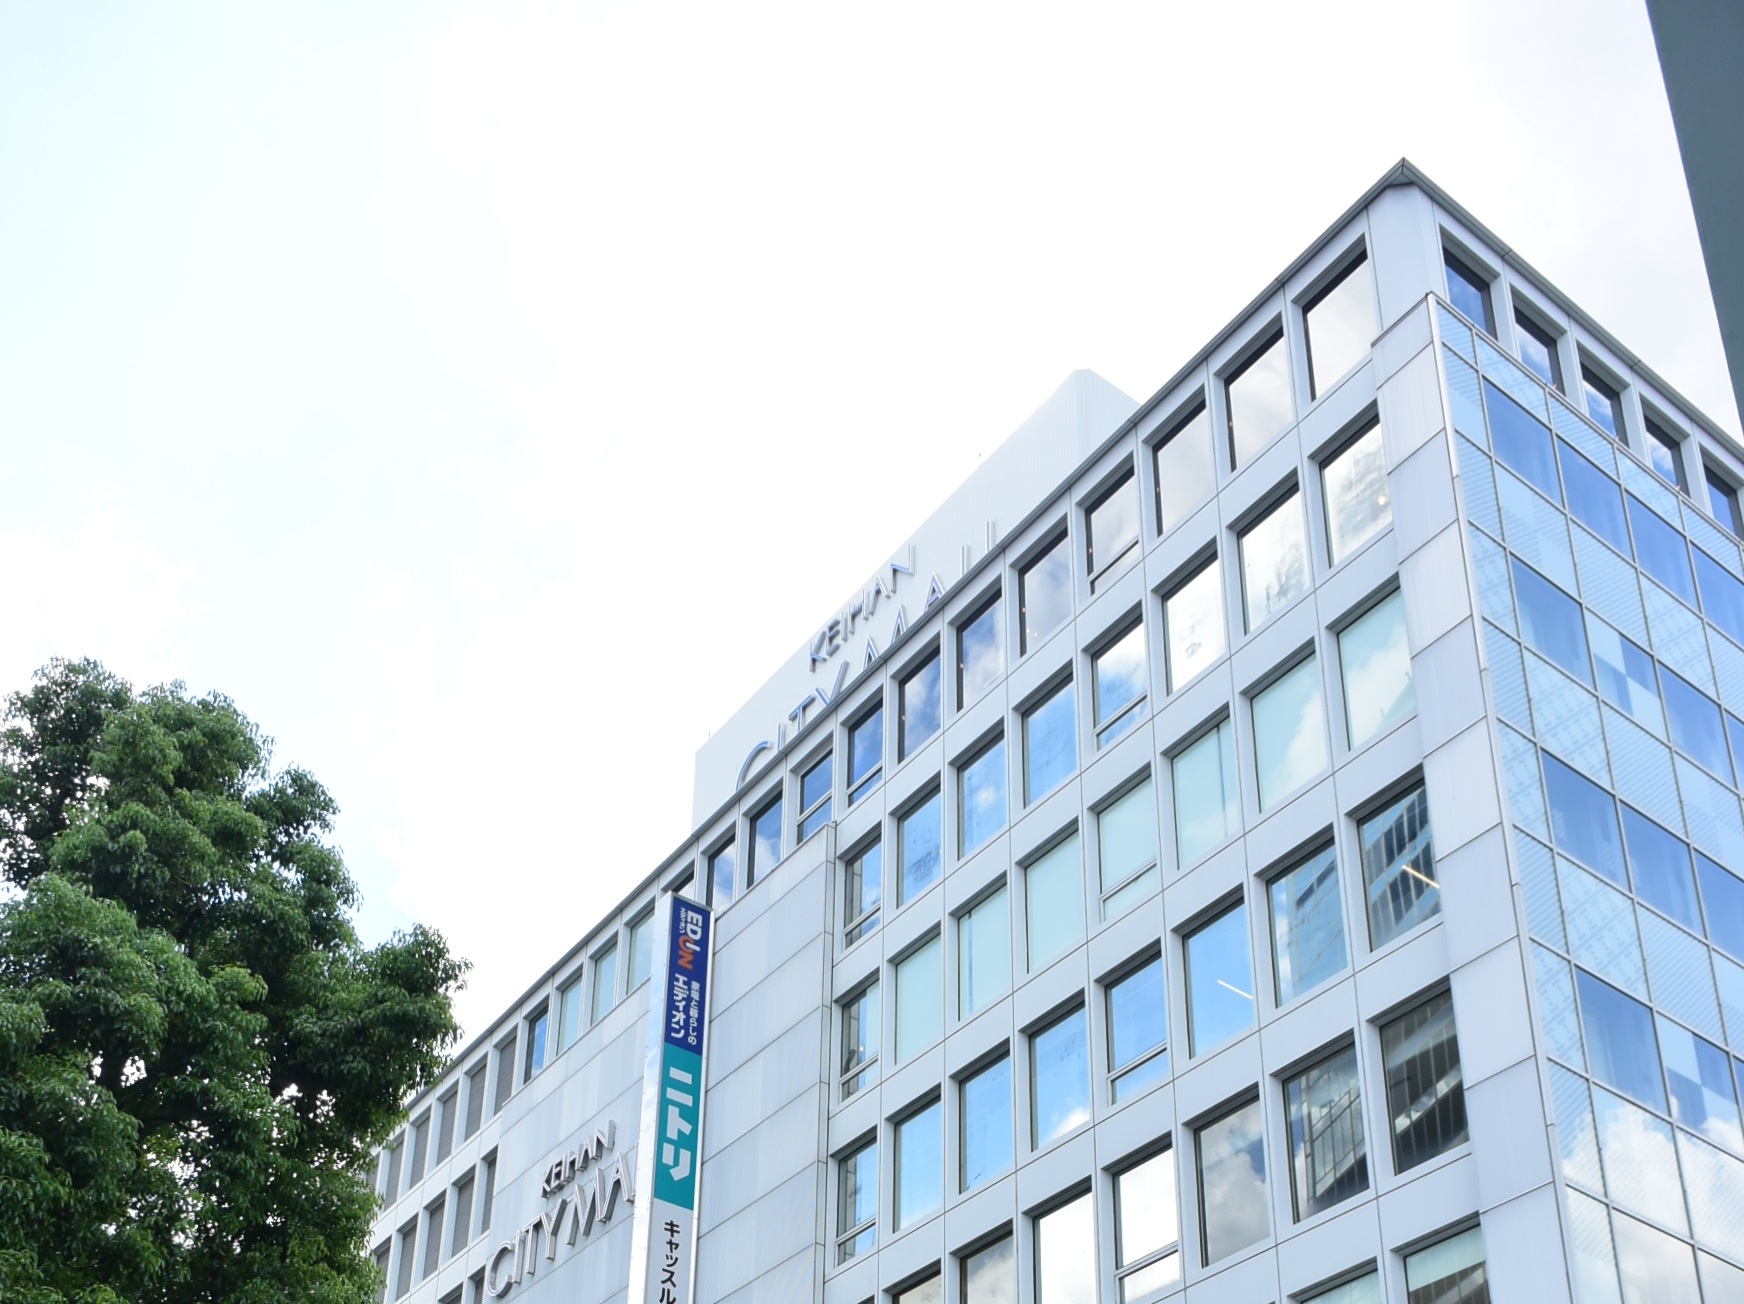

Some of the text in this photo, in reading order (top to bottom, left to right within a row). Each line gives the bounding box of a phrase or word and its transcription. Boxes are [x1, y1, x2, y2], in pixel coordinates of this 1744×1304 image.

[808, 543, 915, 673] KEIHAN
[670, 973, 688, 1040] エディオン
[541, 1119, 616, 1198] KEIHAN
[662, 1066, 694, 1182] ニトリ
[486, 1198, 568, 1298] CITY
